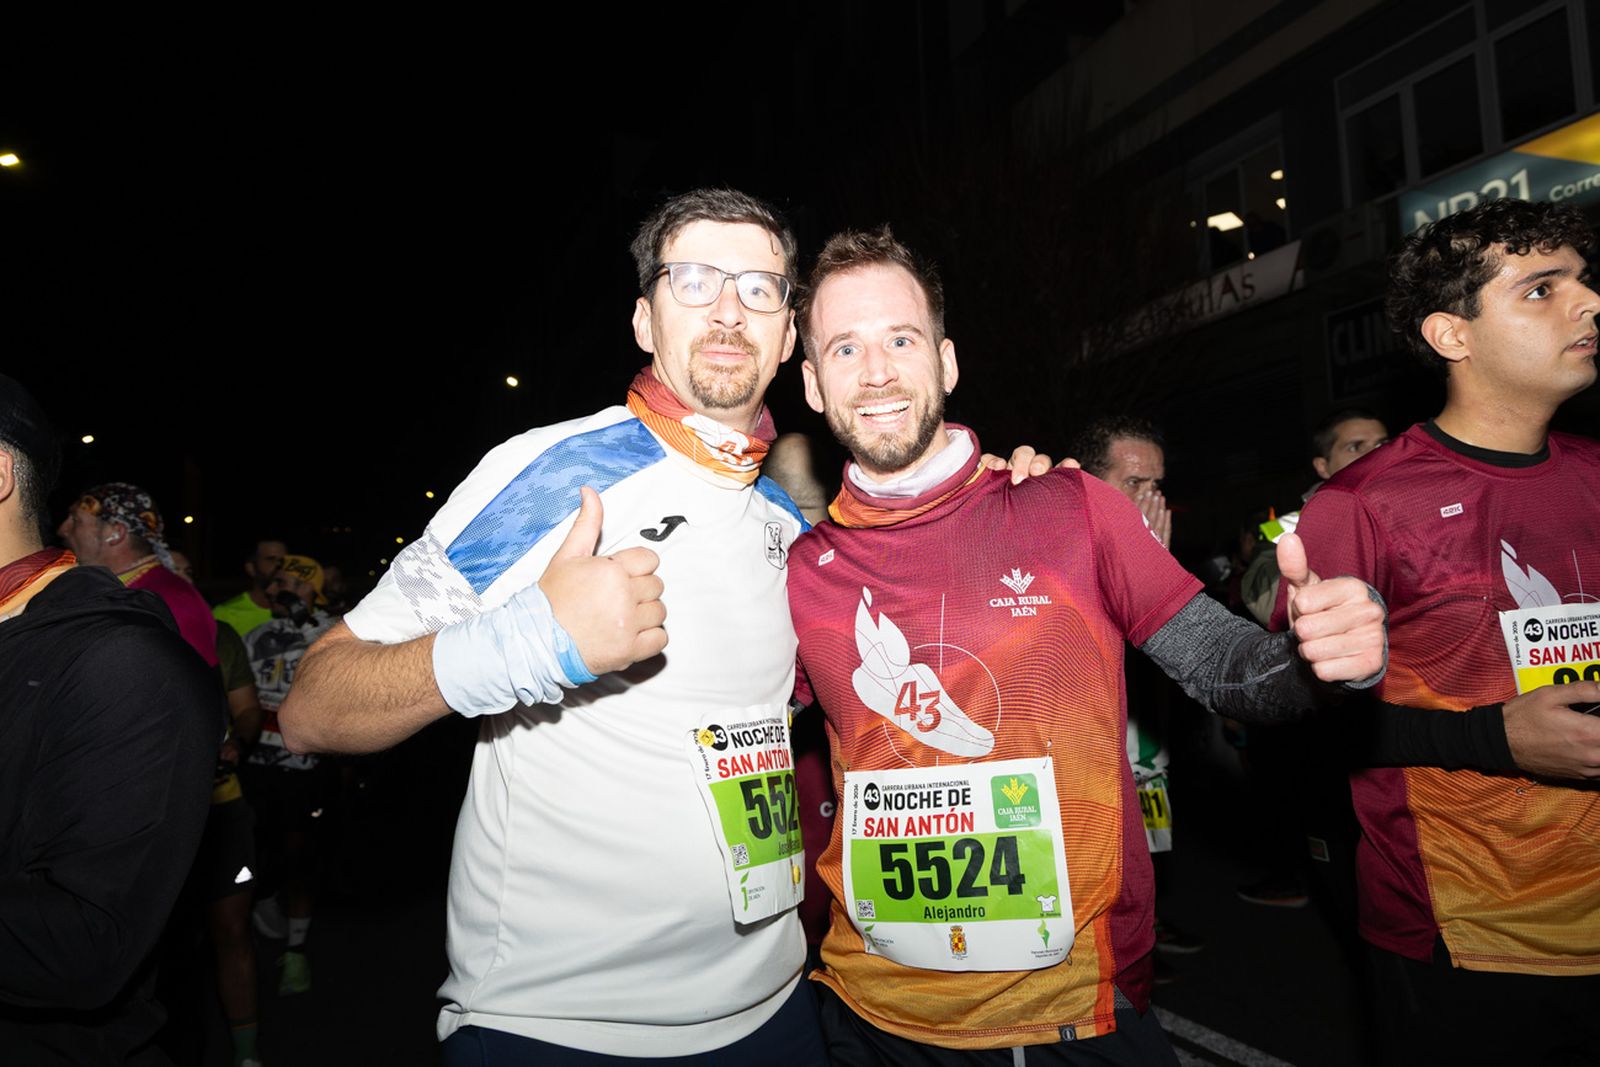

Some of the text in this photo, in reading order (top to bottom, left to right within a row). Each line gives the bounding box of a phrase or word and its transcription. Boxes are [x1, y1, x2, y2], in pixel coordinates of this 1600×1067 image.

[1017, 595, 1052, 606] RURAL
[1524, 623, 1542, 636] 43
[1545, 617, 1567, 625] CARRERA
[1548, 621, 1599, 641] NOCHE
[1529, 645, 1566, 666] SAN
[894, 681, 942, 732] 43
[730, 726, 786, 748] NOCHE DE
[717, 744, 790, 778] SAN ANTÓN
[864, 788, 880, 803] 43
[904, 783, 926, 791] URBANA
[927, 780, 970, 789] INTERNACIONAL
[739, 775, 800, 840] 552
[884, 788, 971, 811] NOCHE DE
[864, 807, 974, 837] SAN ANTÓN
[880, 836, 1026, 900] 5524
[924, 904, 986, 922] Alejandro
